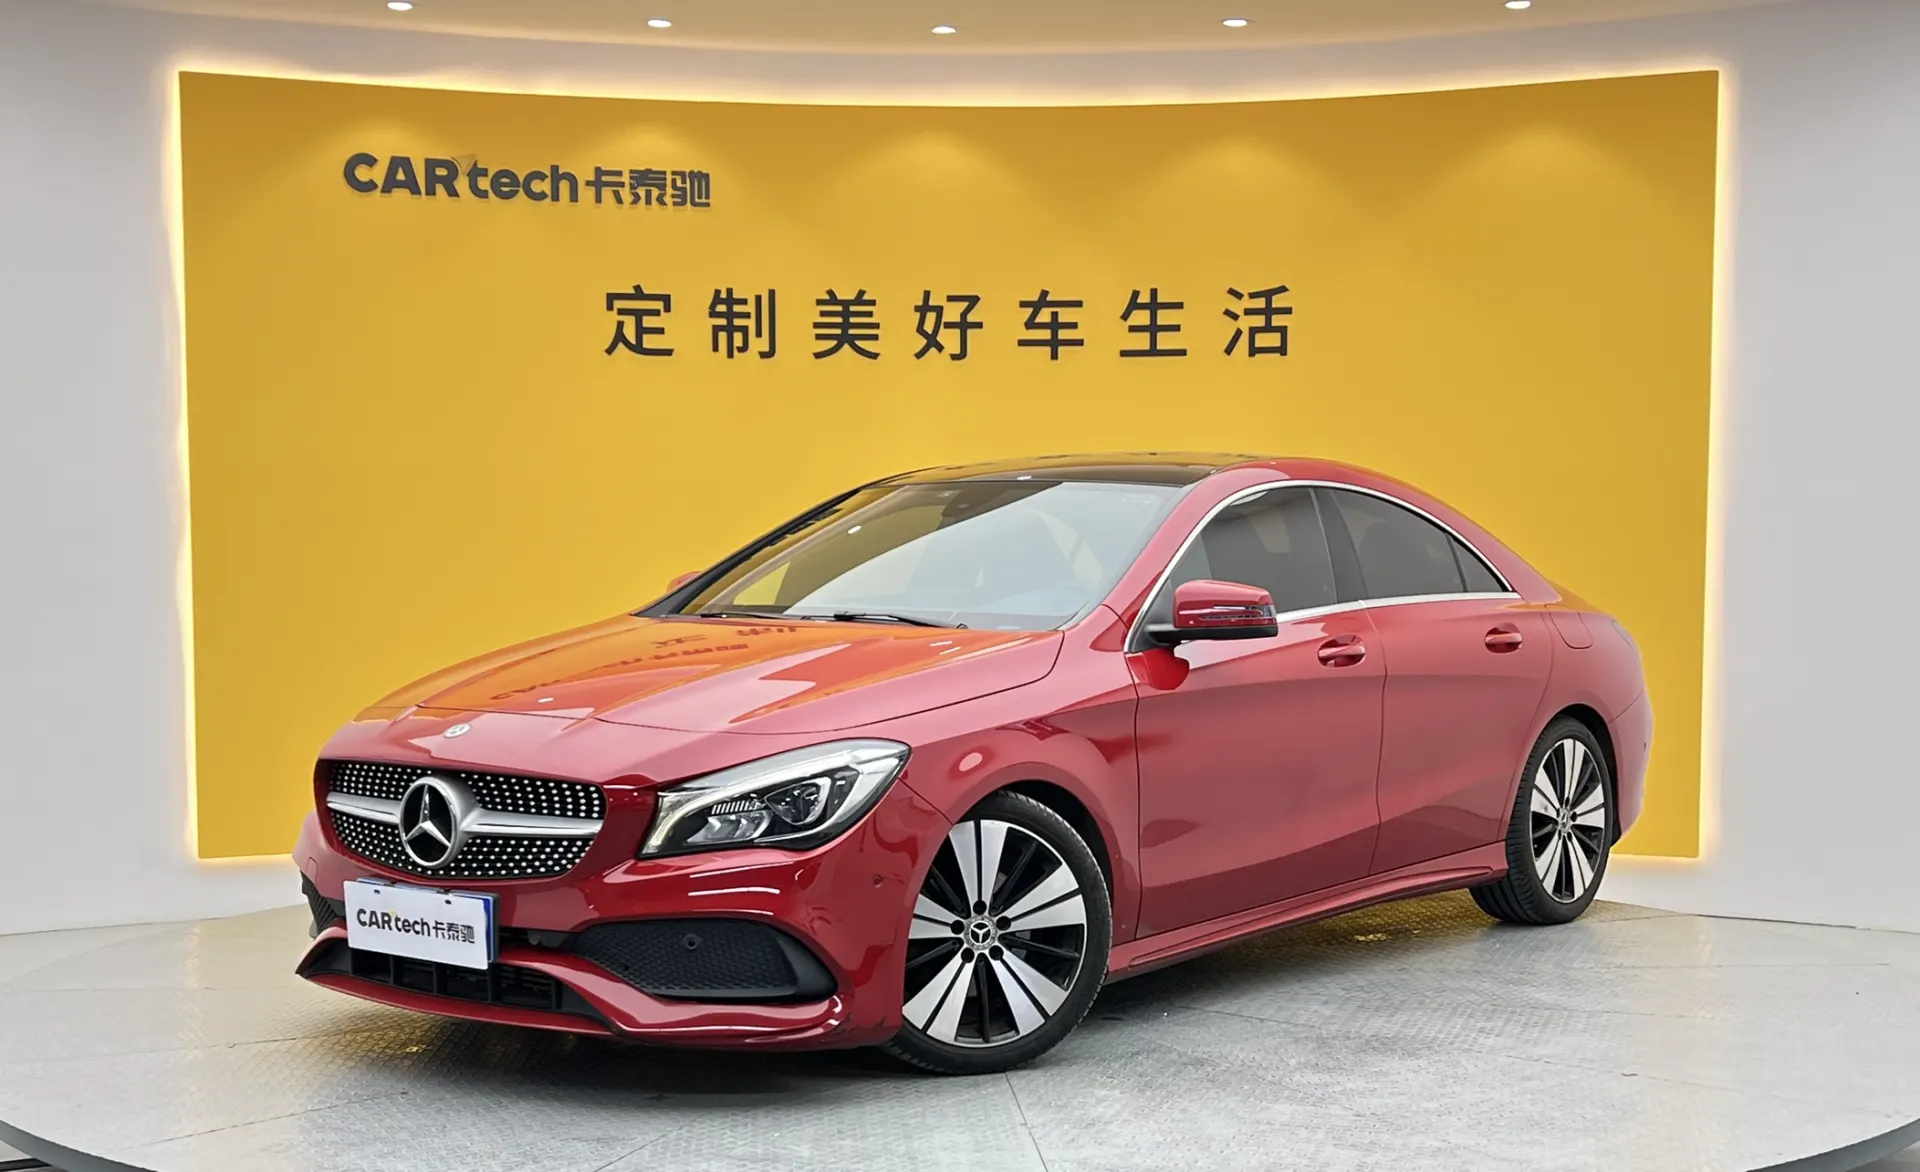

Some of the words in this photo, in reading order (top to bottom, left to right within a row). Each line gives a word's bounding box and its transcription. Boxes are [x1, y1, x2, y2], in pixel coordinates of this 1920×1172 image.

[585, 166, 711, 208] 卡泰驰
[604, 284, 1293, 361] 定制美好车生活
[431, 919, 475, 944] 卡泰驰
